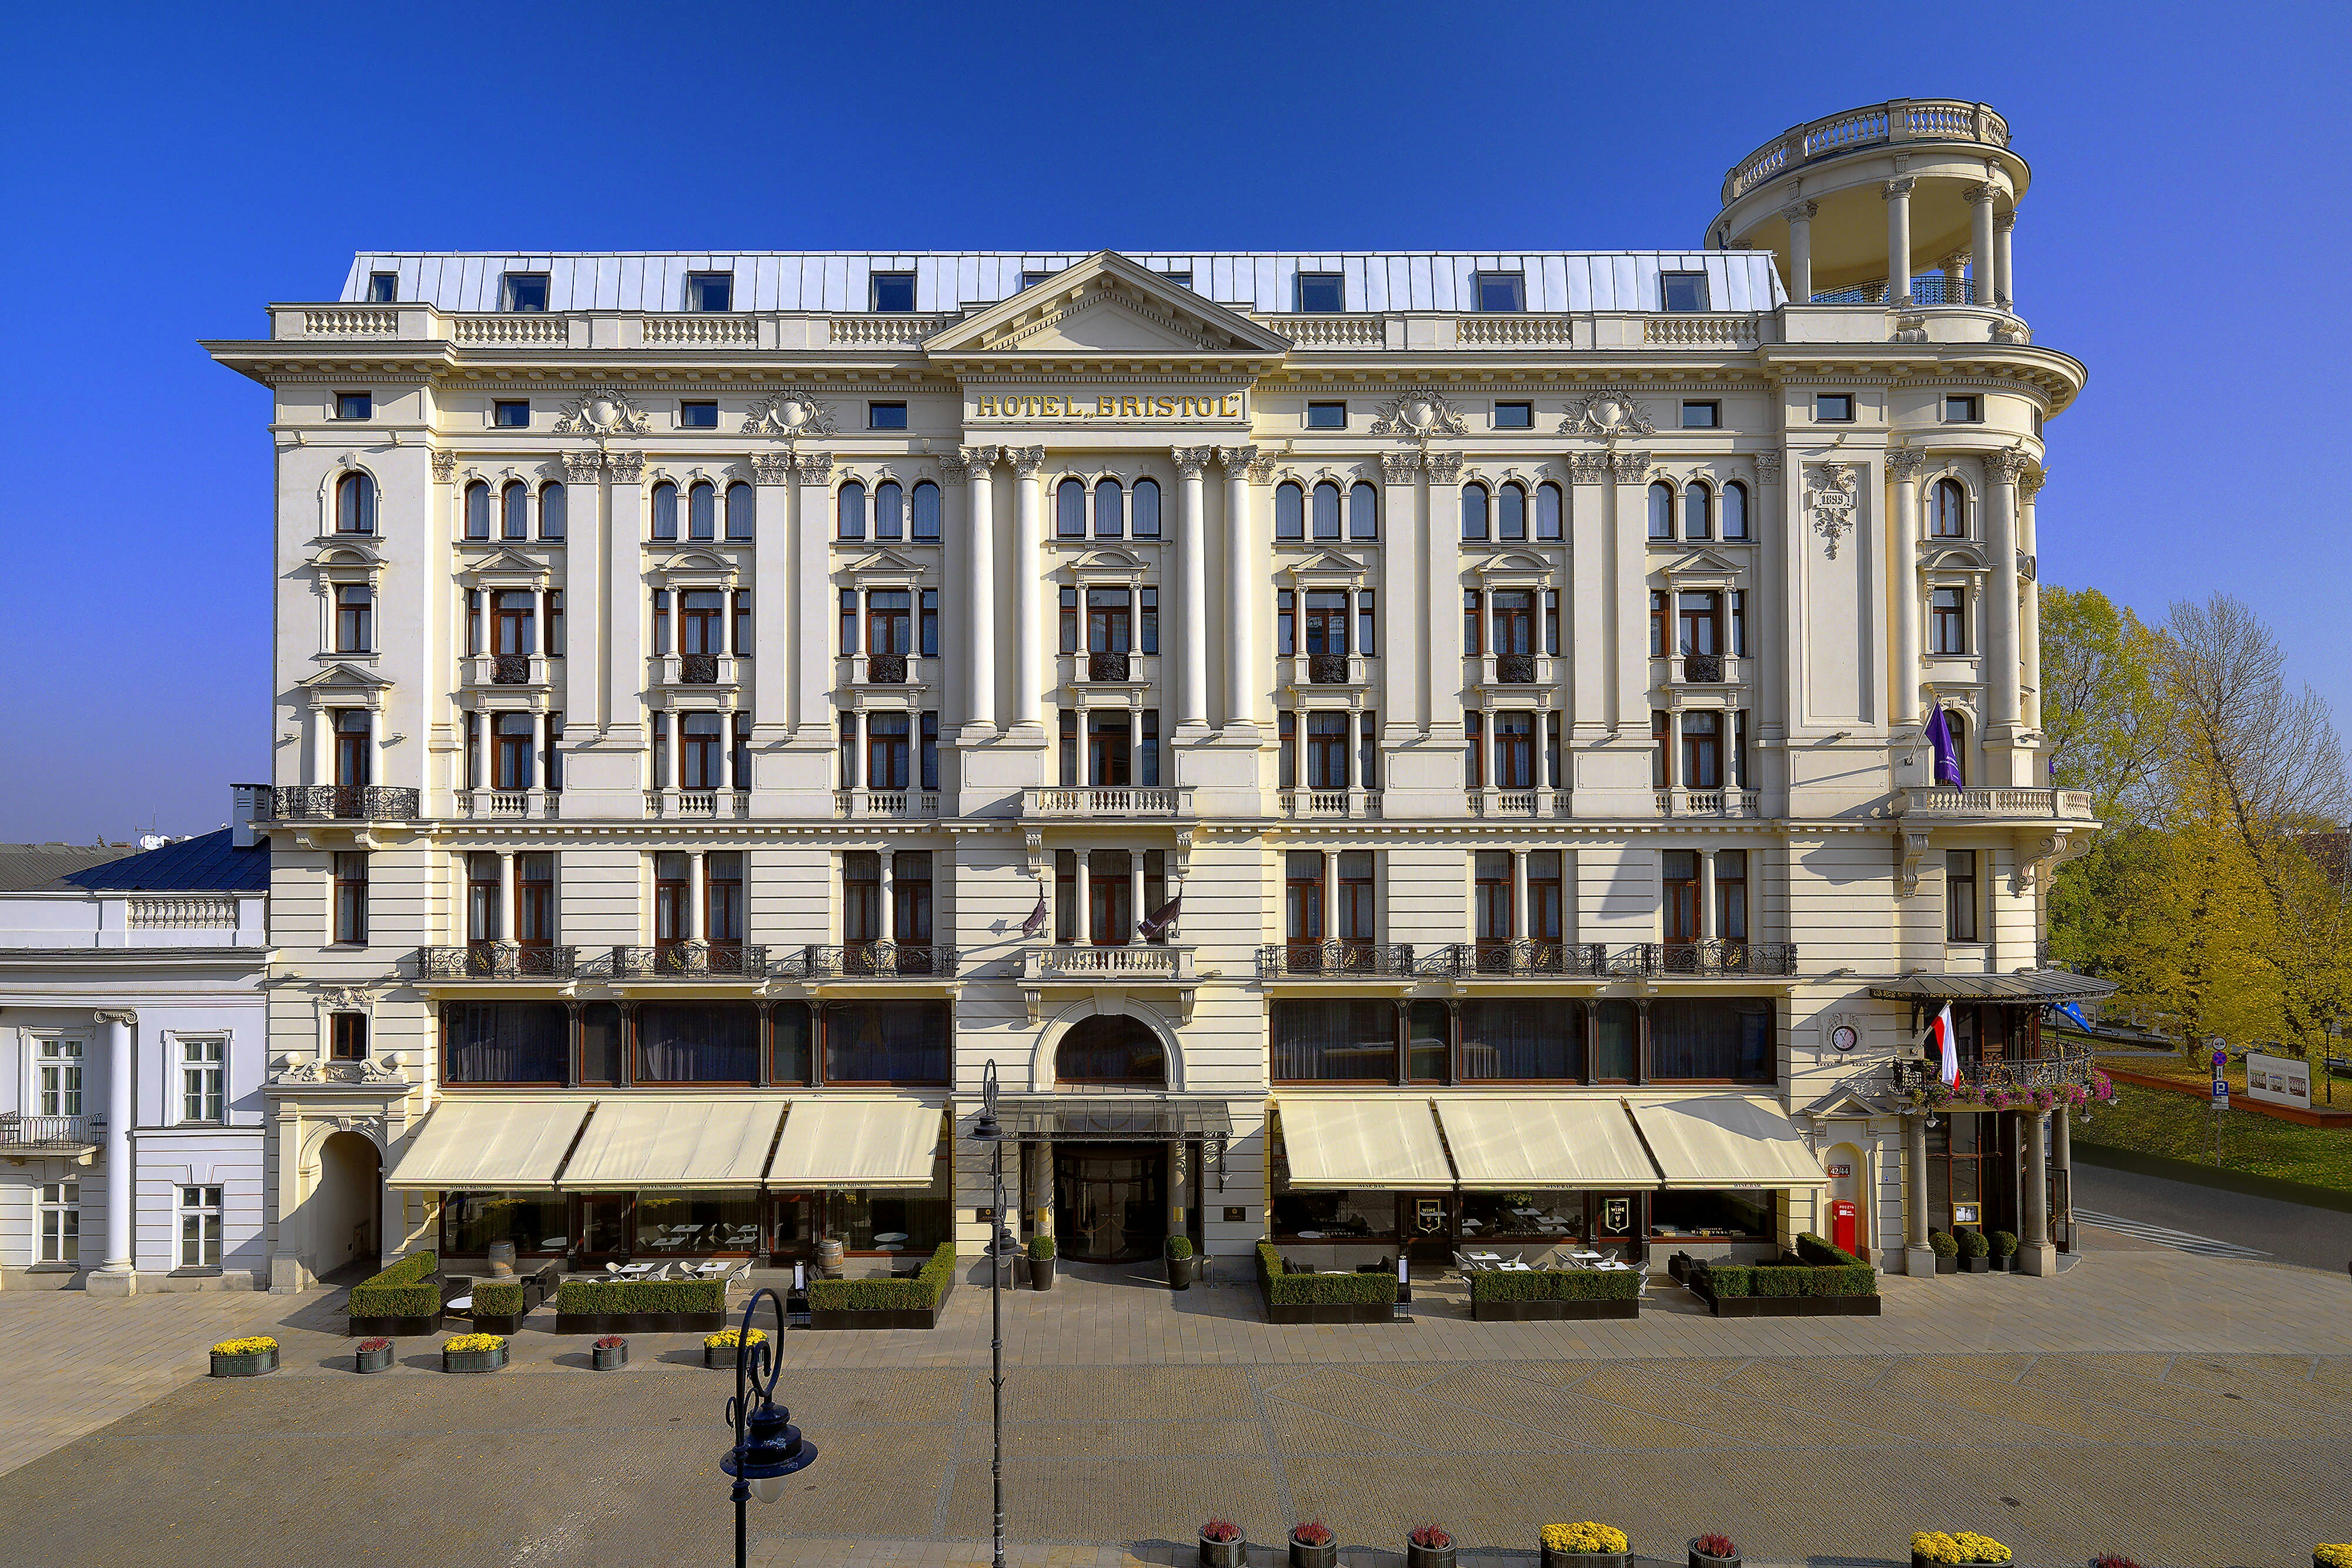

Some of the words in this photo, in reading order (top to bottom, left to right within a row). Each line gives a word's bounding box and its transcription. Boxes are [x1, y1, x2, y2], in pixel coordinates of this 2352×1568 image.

[978, 394, 1083, 416] HOTEL
[1823, 494, 1843, 504] 1899
[2216, 1082, 2225, 1094] P
